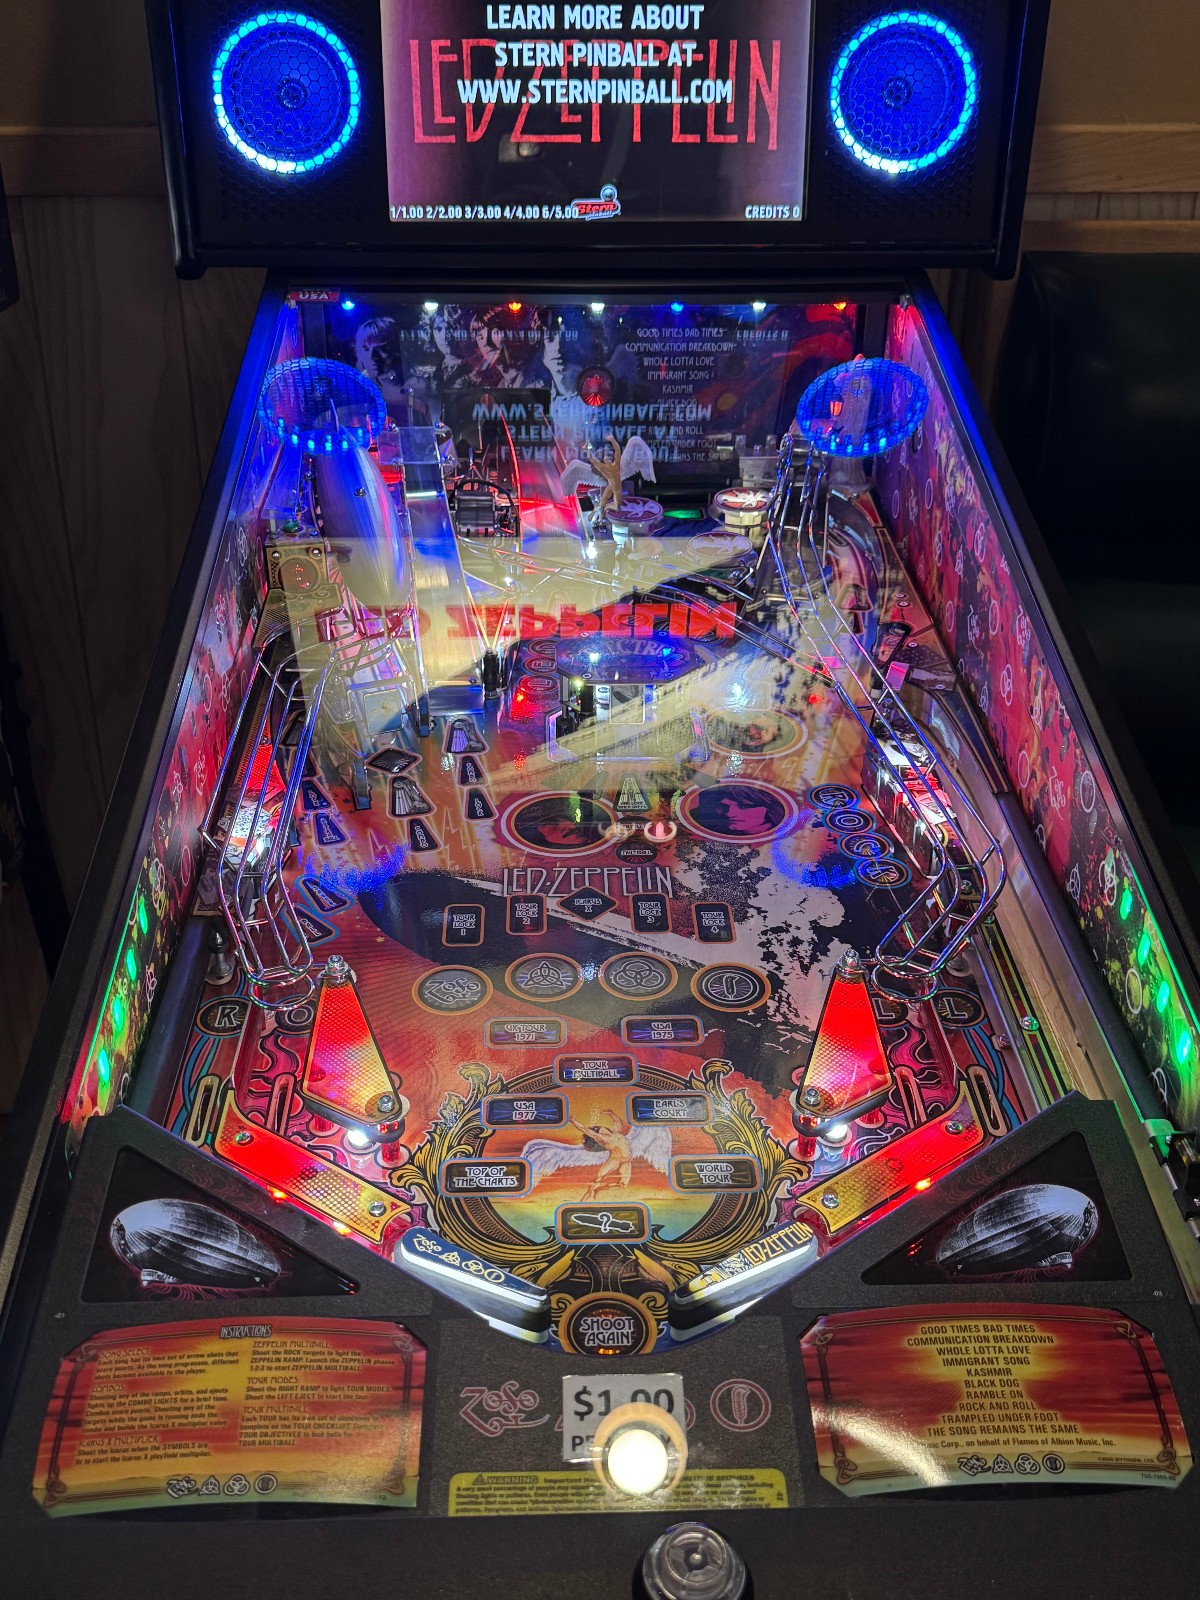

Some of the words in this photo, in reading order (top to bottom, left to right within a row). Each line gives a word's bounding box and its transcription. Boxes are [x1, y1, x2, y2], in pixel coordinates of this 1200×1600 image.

[486, 5, 556, 30] LEARN
[563, 5, 622, 30] MORE
[631, 4, 704, 30] ABOUT
[495, 42, 564, 67] STERN
[573, 42, 659, 67] PINBALL
[668, 42, 698, 66] AT
[457, 79, 733, 104] WWW.STERNPINBALL.COM
[390, 206, 423, 219] 1/1.00
[426, 205, 462, 219] 2/2.00
[465, 205, 501, 219] 3/3.00
[503, 206, 540, 219] 4/4.00
[745, 205, 789, 219] CREDITS
[793, 205, 800, 219] 0
[637, 328, 660, 337] GOOD
[661, 328, 683, 337] TIMES
[685, 328, 700, 337] BAD
[701, 328, 723, 337] TIMES
[625, 343, 686, 352] COMMUNICATION
[688, 343, 734, 352] BREAKDOWN
[643, 357, 669, 366] WHOLE
[670, 357, 694, 366] LOTTA
[695, 357, 714, 366] LOVE
[647, 371, 687, 380] IMMIGRANT
[688, 371, 709, 380] SONG
[662, 385, 693, 394] KASHMIR
[515, 903, 539, 911] TOUR
[515, 910, 538, 918] LOCK
[453, 921, 476, 929] LOCK
[943, 997, 968, 1018] L
[504, 1023, 519, 1032] UK
[520, 1023, 547, 1032] TOUR
[651, 1022, 672, 1031] USA
[515, 1032, 536, 1041] 1971
[651, 1031, 673, 1040] 1975
[583, 1060, 609, 1069] TOUR
[513, 1102, 535, 1111] USA
[512, 1111, 536, 1120] 1977
[653, 1108, 688, 1118] COURT
[465, 1166, 488, 1177] TOP
[490, 1166, 505, 1177] OF
[695, 1163, 733, 1174] WORLD
[453, 1177, 475, 1188] THE
[476, 1177, 518, 1188] CHARTS
[701, 1173, 732, 1184] TOUR
[580, 1317, 634, 1332] SHOOT
[921, 1325, 947, 1335] GOOD
[949, 1325, 980, 1334] TIMES
[983, 1324, 1003, 1333] BAD
[1005, 1324, 1035, 1333] TIMES
[220, 1325, 272, 1338] INSTRUCTIONS
[585, 1331, 632, 1346] AGAIN
[907, 1335, 990, 1347] COMMUNICATION
[993, 1335, 1054, 1344] BREAKDOWN
[936, 1346, 970, 1356] WHOLE
[973, 1346, 1004, 1355] LOTTA
[1007, 1345, 1031, 1354] LOVE
[943, 1357, 1000, 1367] IMMIGRANT
[1003, 1357, 1030, 1365] SONG
[966, 1367, 1012, 1377] KASHMIR
[964, 1379, 997, 1388] BLACK
[999, 1379, 1020, 1388] DOG
[966, 1390, 1008, 1400] RAMBLE
[1010, 1390, 1024, 1399] ON
[959, 1402, 986, 1412] ROCK
[989, 1402, 1010, 1411] AND
[1012, 1401, 1036, 1410] ROLL
[941, 1414, 996, 1424] TRAMPLED
[999, 1413, 1032, 1422] UNDER
[1034, 1412, 1059, 1422] FOOT
[926, 1427, 946, 1437] THE
[949, 1426, 977, 1436] SONG
[980, 1425, 1026, 1435] REMAINS
[1028, 1424, 1048, 1434] THE
[1050, 1424, 1080, 1434] SAME
[163, 1442, 196, 1450] SYMBOLS
[976, 1438, 1000, 1446] behalf
[1002, 1438, 1010, 1446] of
[1012, 1438, 1039, 1446] Flames
[1051, 1437, 1074, 1445] Albion
[1076, 1437, 1101, 1446] Music,
[1102, 1438, 1116, 1446] Inc.
[487, 1475, 538, 1484] WARNING
